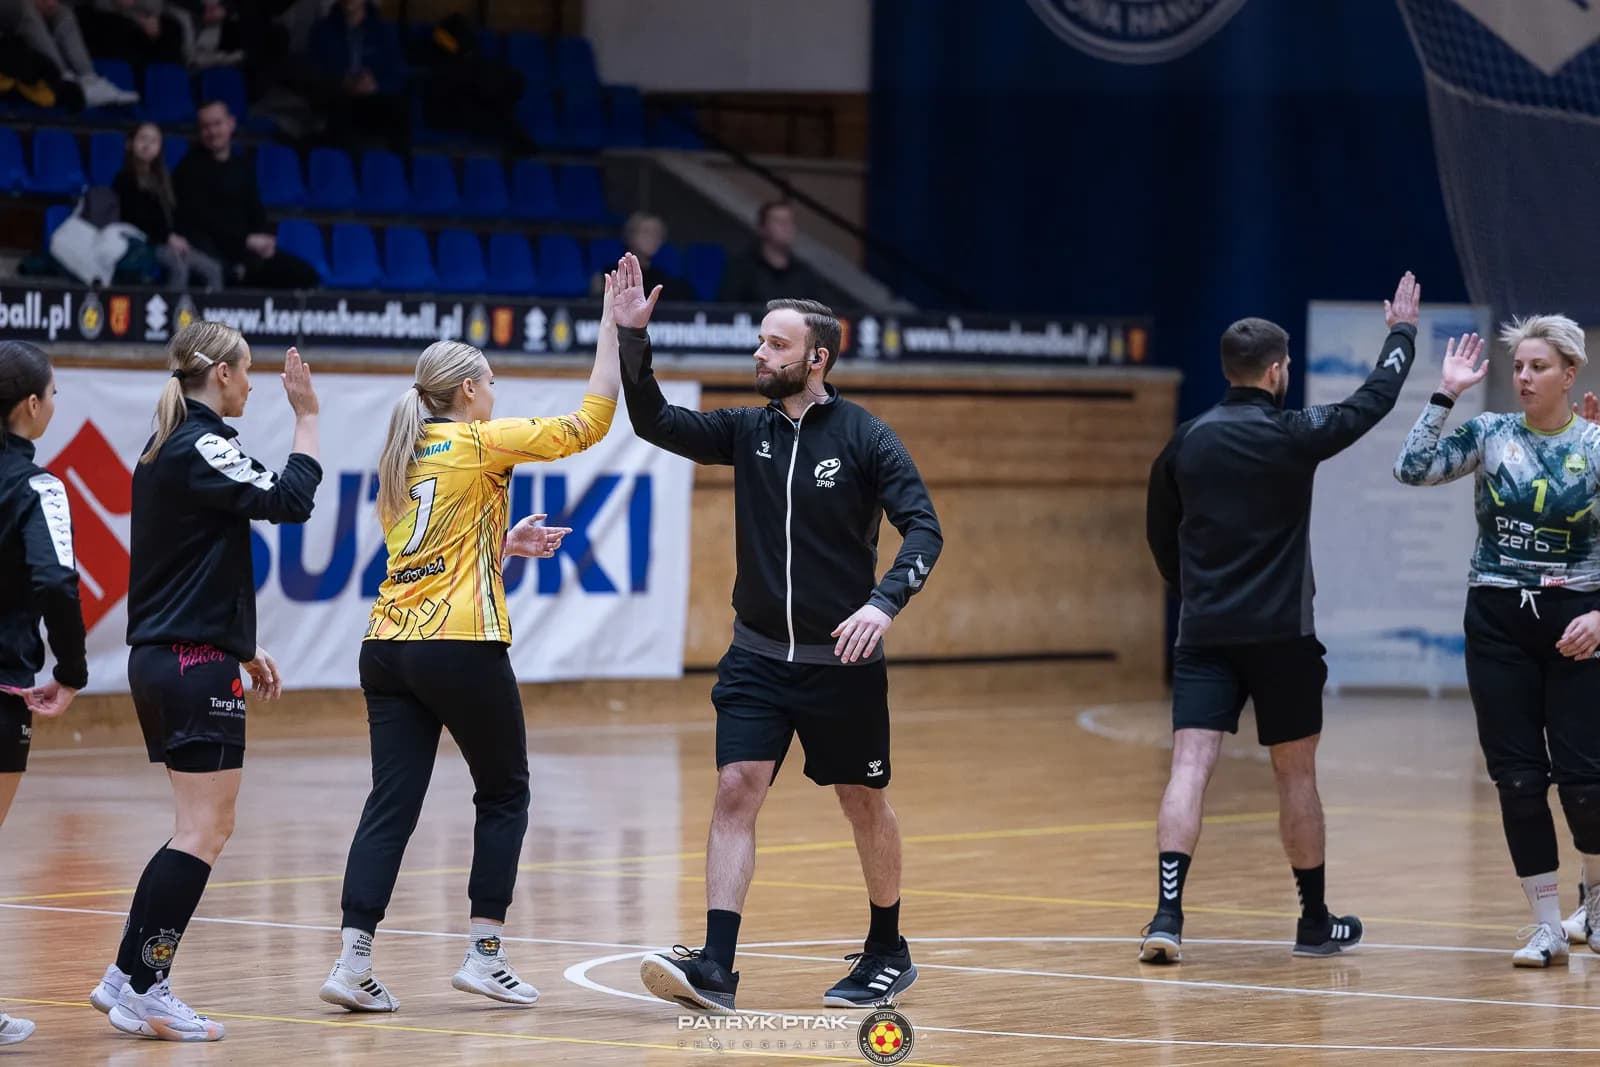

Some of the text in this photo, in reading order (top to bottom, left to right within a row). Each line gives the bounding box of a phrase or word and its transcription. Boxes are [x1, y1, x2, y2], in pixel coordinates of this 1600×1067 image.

[816, 479, 836, 489] ZPRP
[1531, 478, 1548, 513] 1
[401, 476, 438, 557] 1
[1495, 516, 1534, 534] pre
[250, 472, 652, 605] UKI
[1497, 533, 1550, 553] zero
[209, 697, 235, 711] Targi
